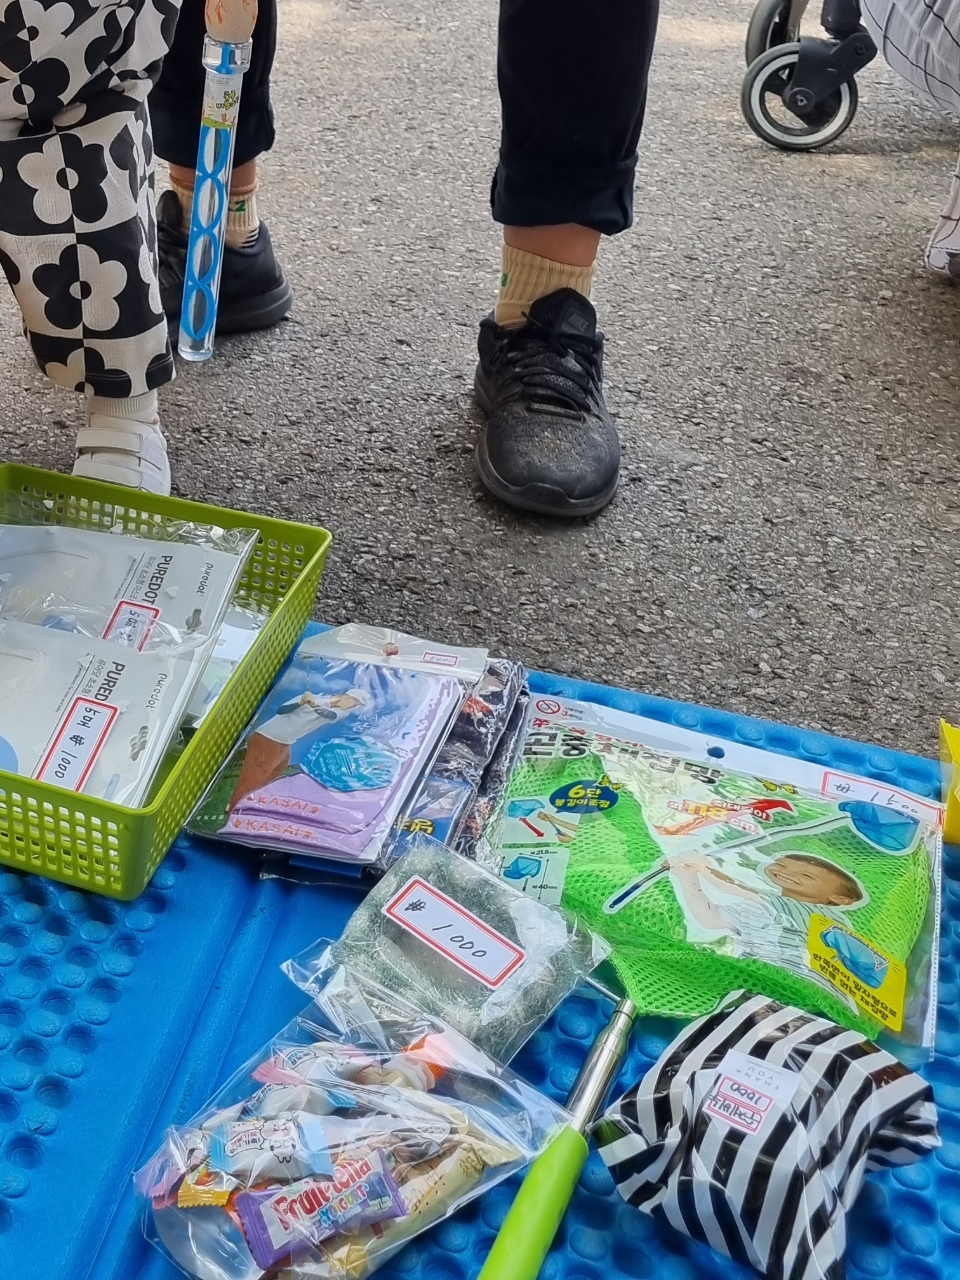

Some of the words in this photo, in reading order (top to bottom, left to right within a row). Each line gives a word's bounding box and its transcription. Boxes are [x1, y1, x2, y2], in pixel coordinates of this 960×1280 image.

[141, 554, 174, 606] PUREDOT
[94, 660, 126, 702] PURED
[146, 672, 168, 710] puredot
[54, 750, 78, 779] 1000
[257, 795, 308, 811] KASAI
[246, 819, 300, 837] KASAI
[431, 923, 487, 958] 1000
[734, 1067, 780, 1091] THANK
[747, 1066, 774, 1081] YOU
[729, 1081, 763, 1106] 1000
